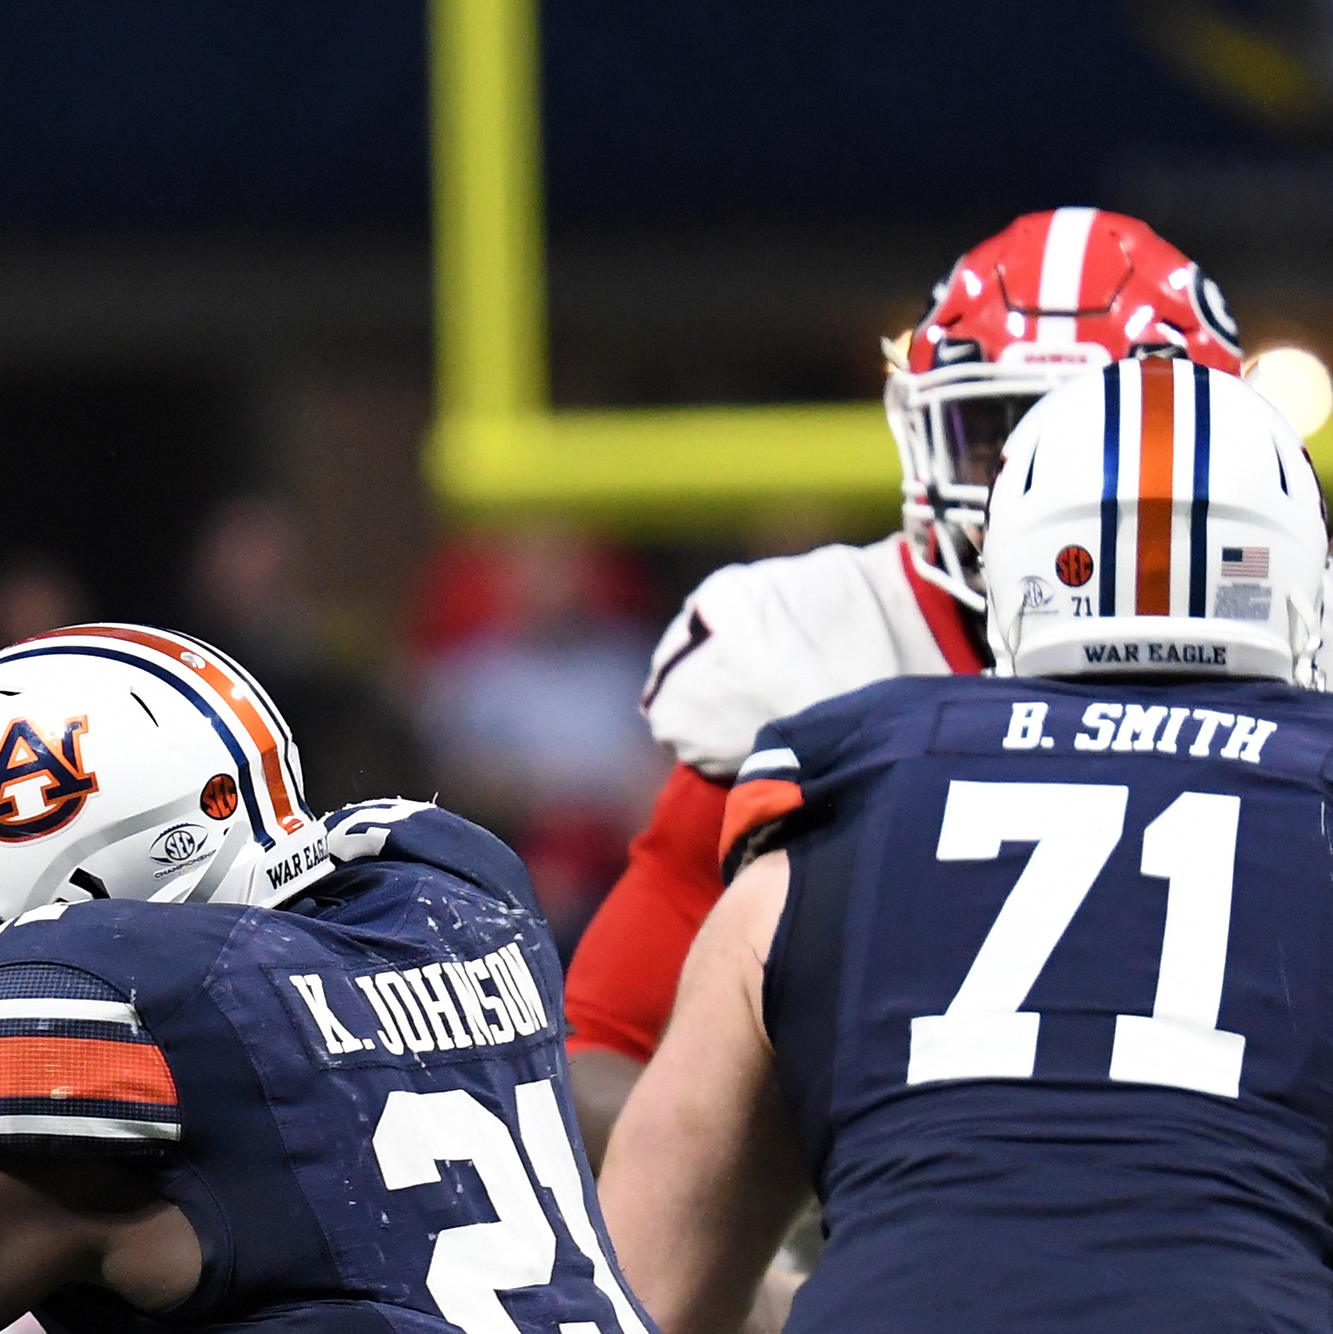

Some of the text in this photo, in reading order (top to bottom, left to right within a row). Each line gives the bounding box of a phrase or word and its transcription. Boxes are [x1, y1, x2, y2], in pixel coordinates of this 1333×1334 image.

[1056, 546, 1093, 588] SEC
[1071, 596, 1093, 617] 71
[1083, 643, 1227, 665] WAR EAGLE
[1002, 702, 1278, 764] B. SMITH
[165, 831, 195, 860] SEC
[265, 852, 304, 890] WAR
[906, 779, 1247, 1099] 71
[290, 942, 549, 1055] K. JOHNSON
